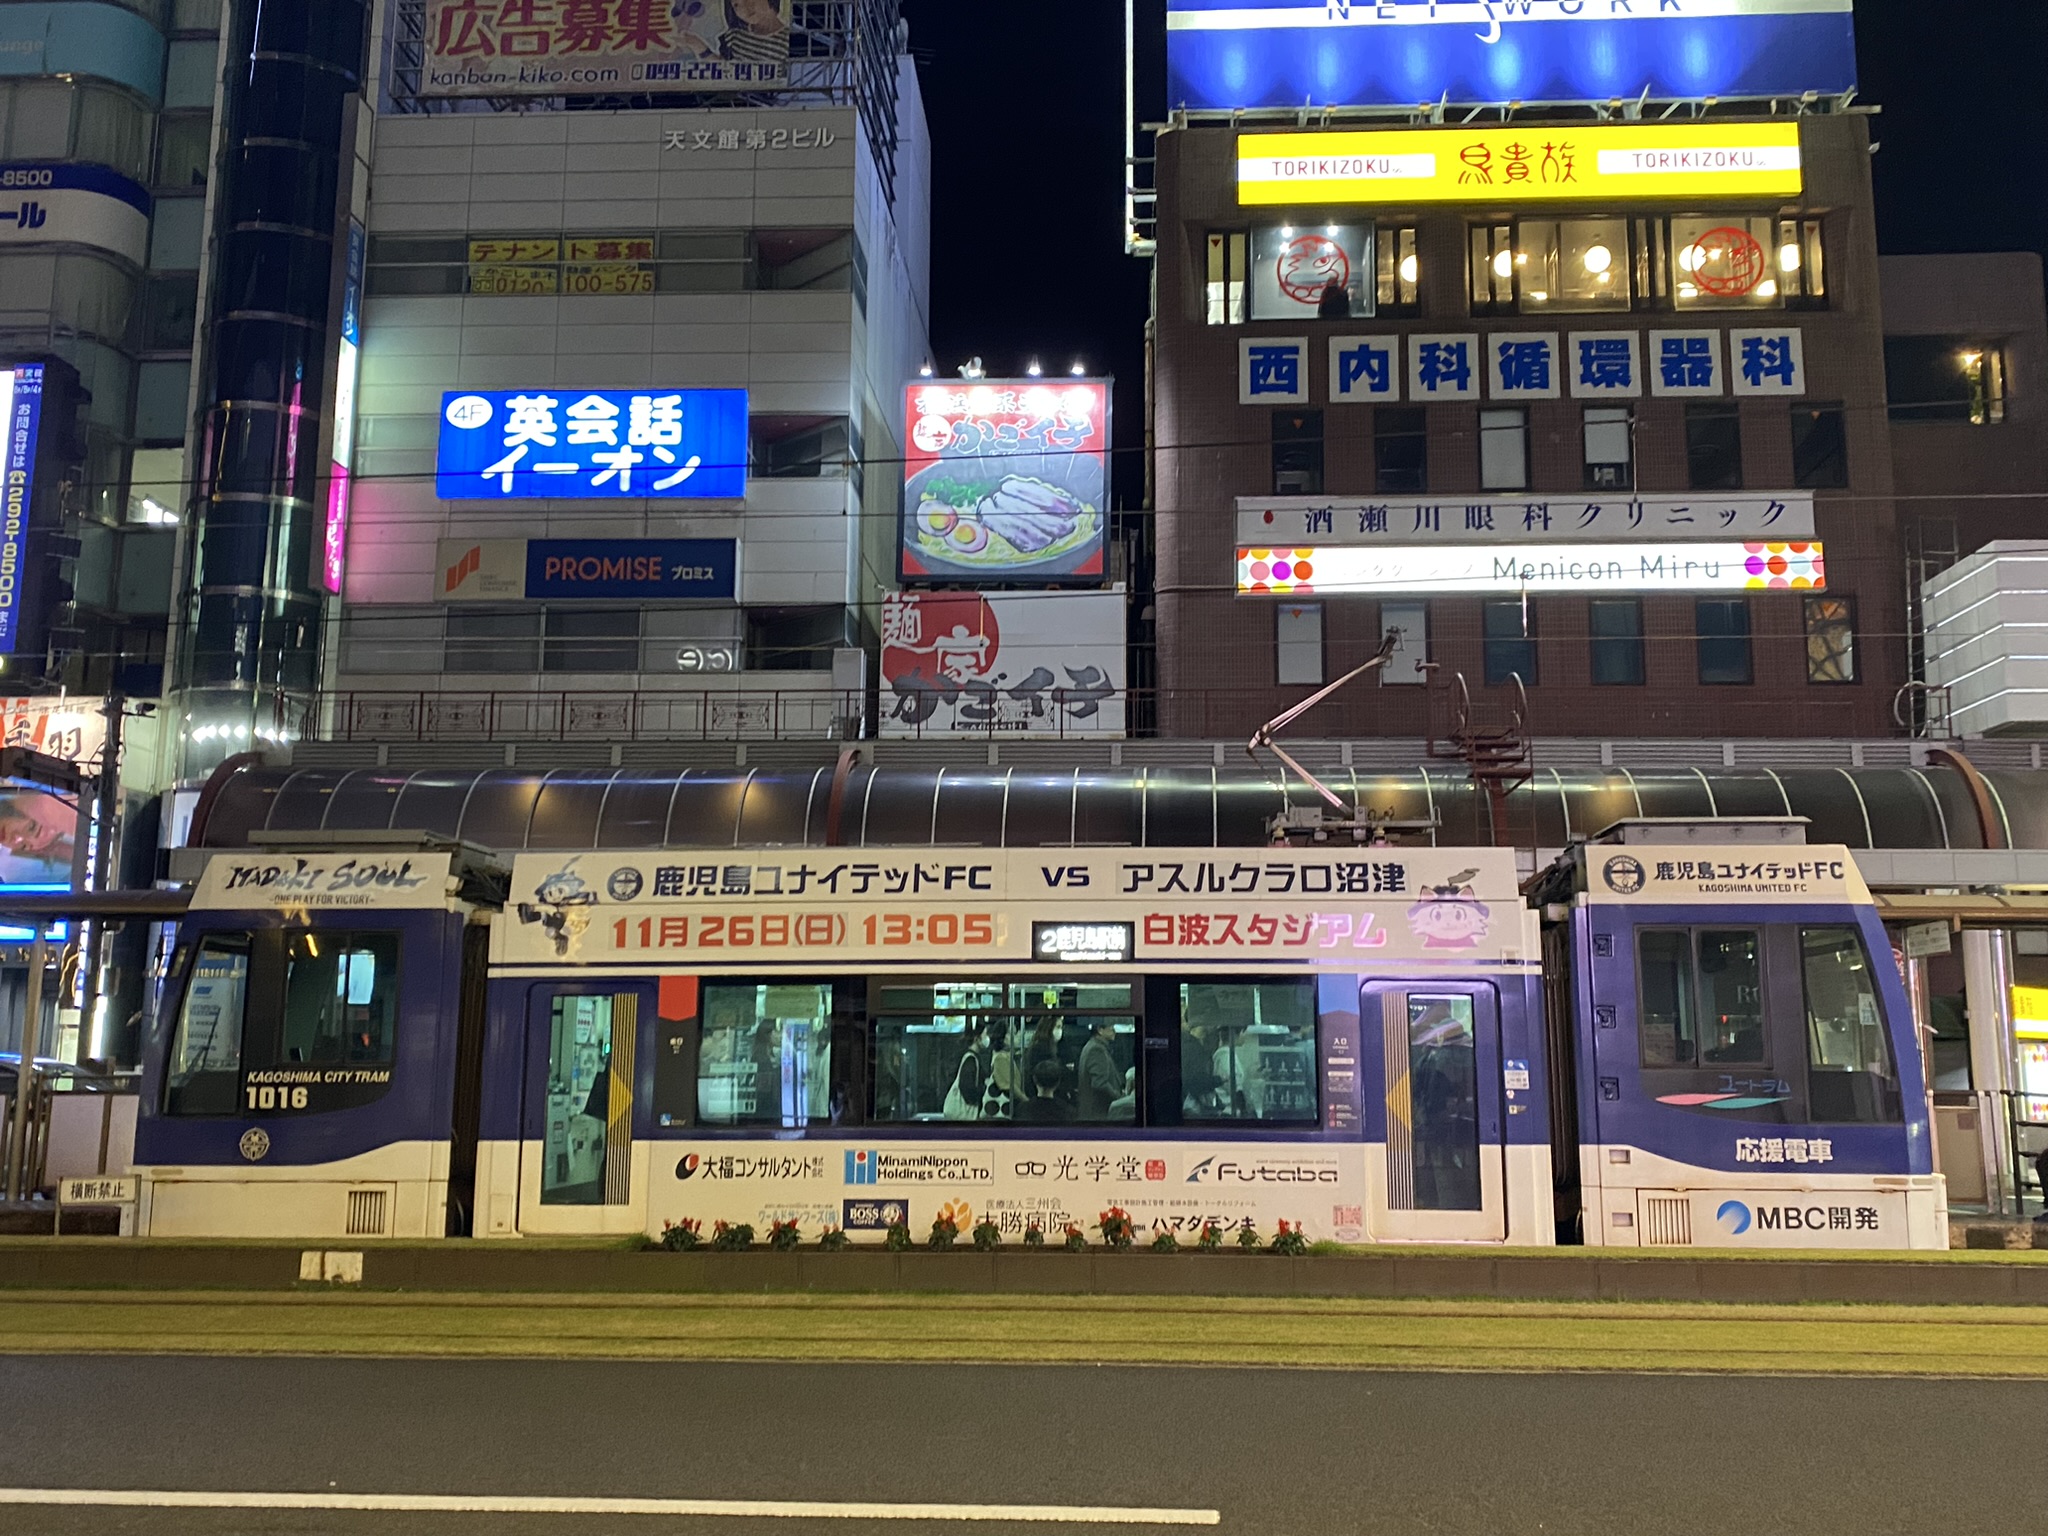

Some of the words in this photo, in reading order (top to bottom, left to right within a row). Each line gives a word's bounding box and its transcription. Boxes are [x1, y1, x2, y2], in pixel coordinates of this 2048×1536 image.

[435, 0, 672, 57] 広告募集
[430, 65, 618, 86] kanban-kiko.com
[665, 127, 835, 151] 天文館第2ビル
[1272, 159, 1390, 176] TORIKIZOKU
[1458, 142, 1577, 184] 鳥貴族
[1633, 151, 1753, 168] TORIKIZOKU
[474, 242, 652, 261] テナント募集
[453, 404, 483, 421] 4F
[503, 394, 684, 447] 英会話
[480, 444, 702, 493] イーオン
[1305, 499, 1786, 533] 酒瀬川眼科クリニック
[545, 556, 662, 581] PROMISE
[671, 565, 714, 581] プロミス
[1493, 556, 1622, 581] Menicon
[1641, 555, 1720, 579] Miru
[327, 859, 427, 892] SOUL
[652, 863, 993, 897] 鹿児島ユナイテッドFC
[1041, 866, 1090, 888] VS
[1122, 862, 1407, 894] アスルクラロ沼津
[1654, 860, 1845, 882] 鹿児島ユナイテッドFC
[1698, 883, 1753, 892] KAGOSHIMA
[1755, 883, 1791, 892] UNITED
[1793, 883, 1808, 892] FC
[316, 895, 332, 905] FOR
[612, 914, 847, 949] 11月26日(日)
[863, 913, 993, 946] 13:05
[1143, 911, 1388, 946] 白波スタジアム
[248, 1071, 321, 1084] KAGOSHIMA
[324, 1071, 354, 1083] CITY
[355, 1071, 390, 1083] TRAM
[1718, 1075, 1791, 1093] ユートラム
[246, 1086, 308, 1110] 1016
[878, 1155, 968, 1169] MinamiNippon
[1735, 1138, 1833, 1164] 応援電車
[702, 1156, 812, 1180] 大福コンサルタント
[877, 1168, 934, 1181] Holdings
[1053, 1155, 1143, 1182] 光学堂
[1217, 1163, 1338, 1183] Futaba
[70, 1182, 125, 1199] 横断禁止
[849, 1207, 880, 1220] BOSS
[985, 1197, 1062, 1210] 医療法人三州会
[1756, 1206, 1880, 1232] MBC開発
